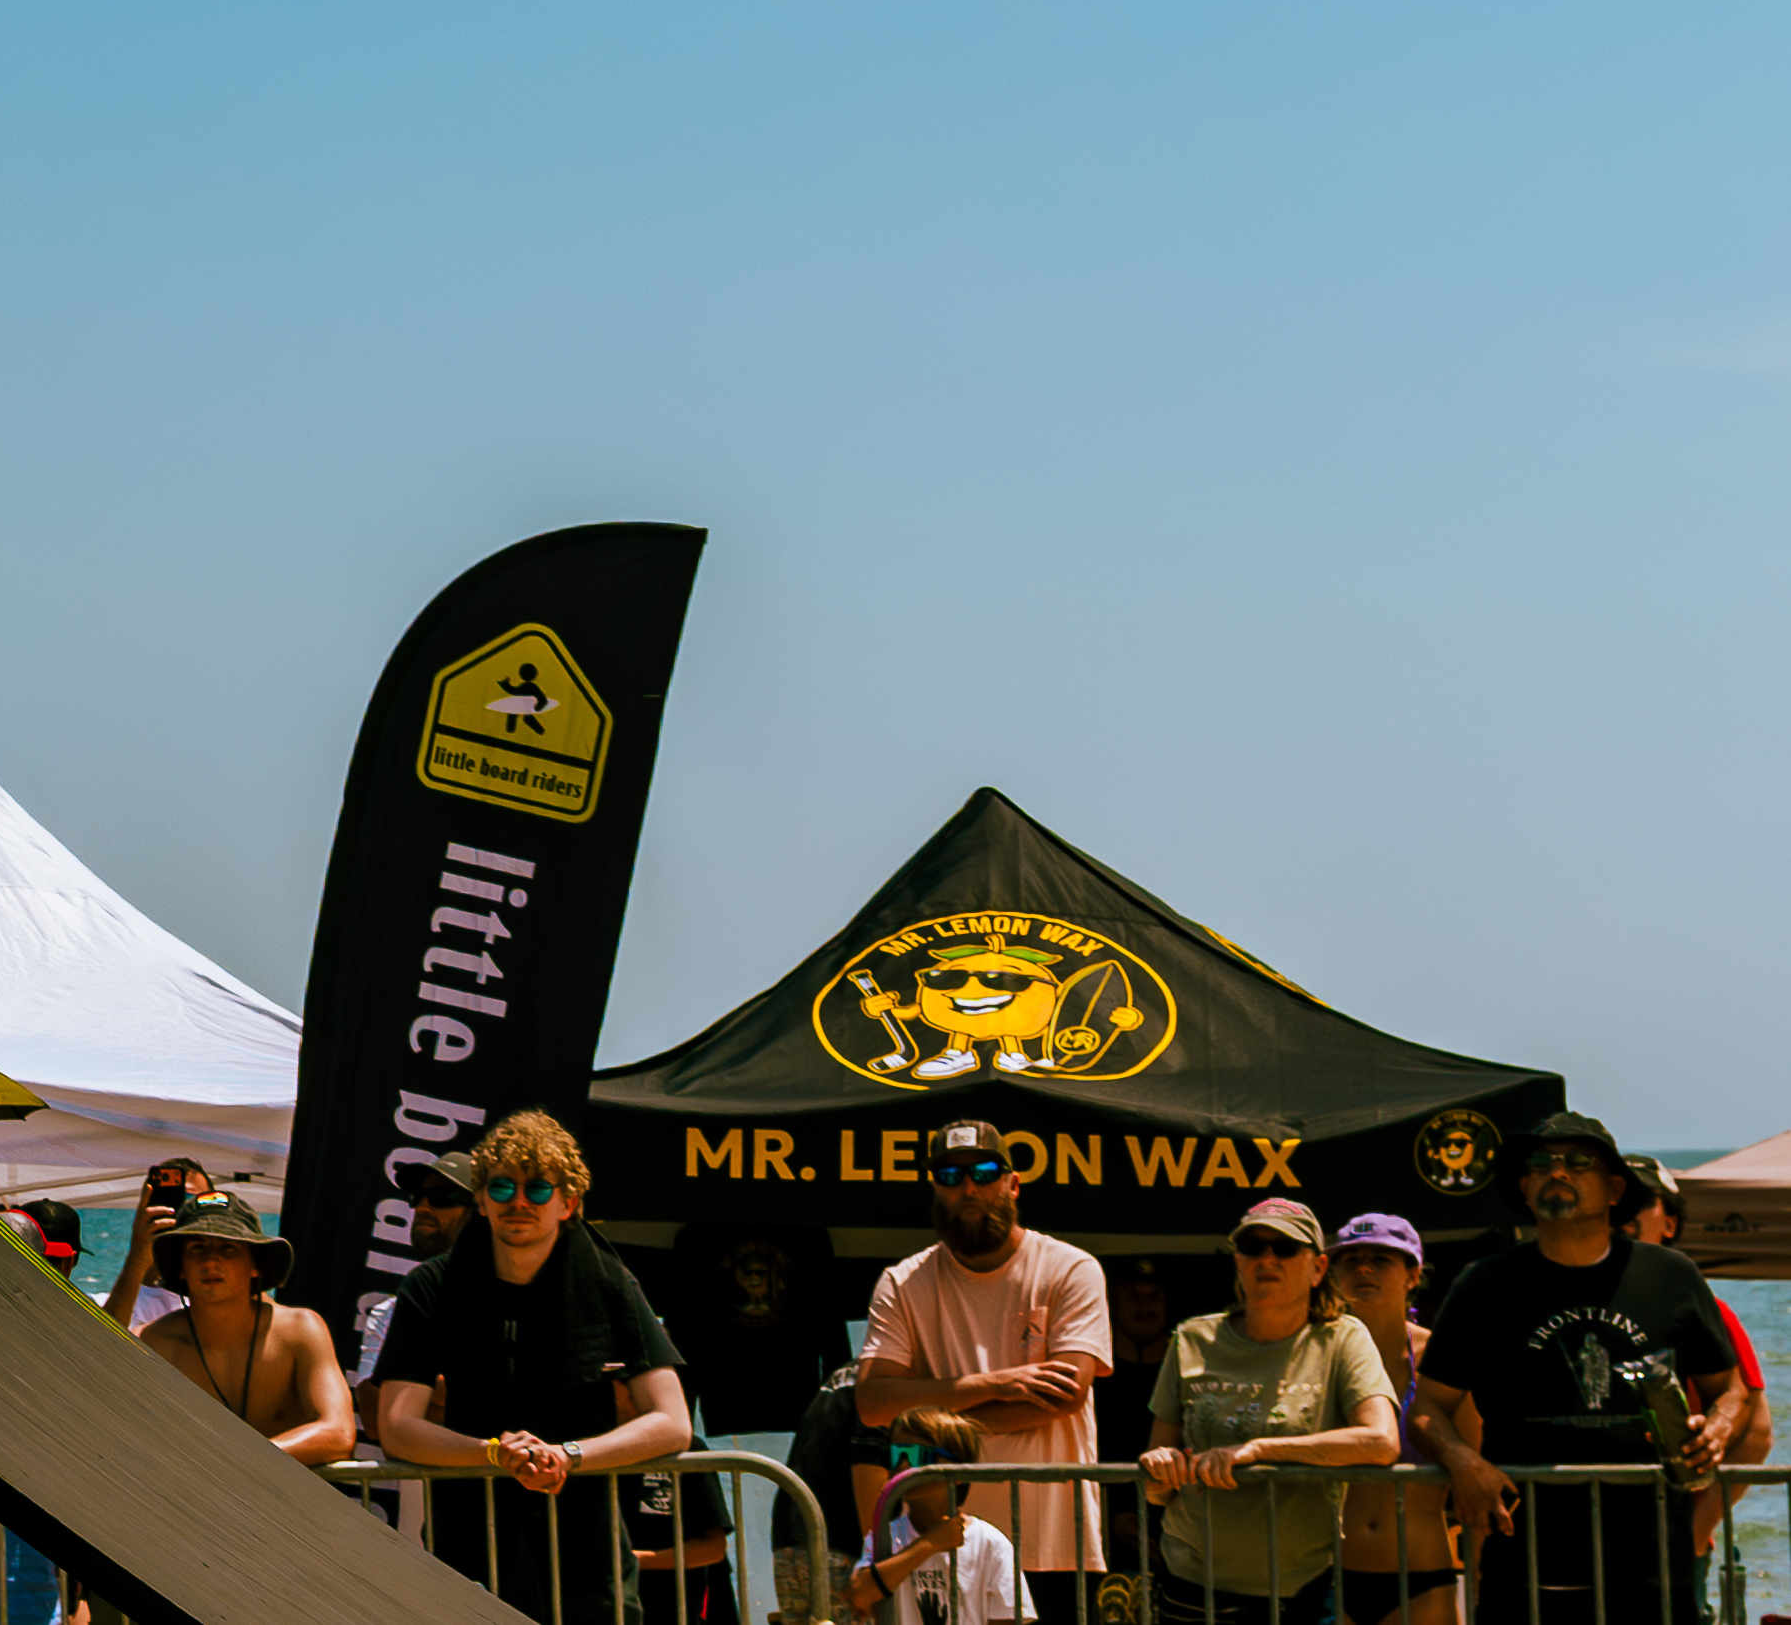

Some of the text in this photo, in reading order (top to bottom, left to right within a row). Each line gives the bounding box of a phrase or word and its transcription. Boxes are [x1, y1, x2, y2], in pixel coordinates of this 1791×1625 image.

[432, 745, 584, 799] little board riders
[408, 841, 537, 1063] little
[879, 915, 1105, 957] MR. LEMON WAX
[685, 1127, 1303, 1189] MR. LEON WAX
[1528, 1306, 1649, 1350] FRONTLINE
